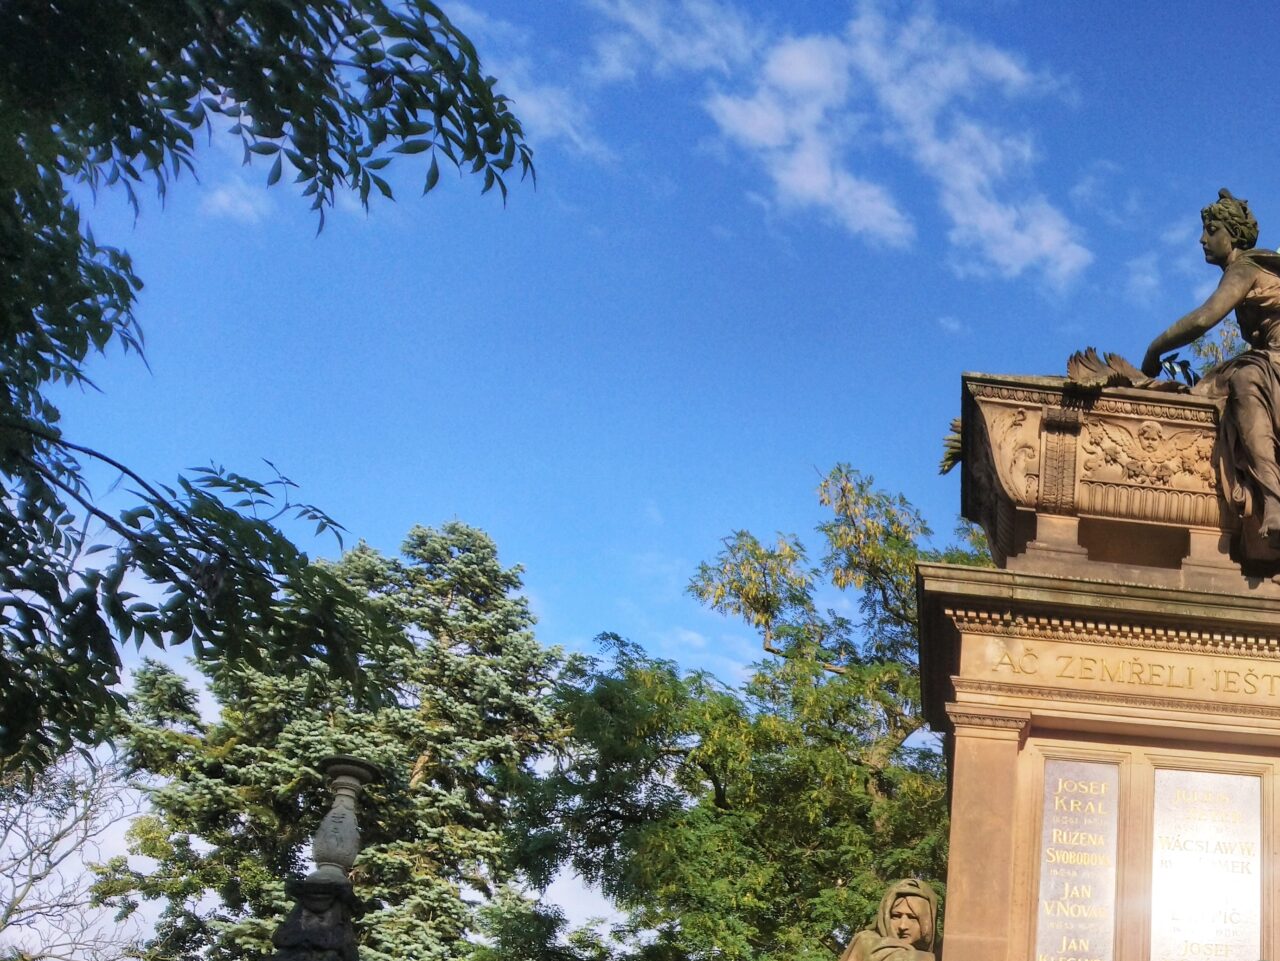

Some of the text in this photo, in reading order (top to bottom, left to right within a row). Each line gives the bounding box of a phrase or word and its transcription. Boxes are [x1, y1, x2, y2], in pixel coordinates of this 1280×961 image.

[991, 647, 1039, 675] AČ
[1055, 655, 1195, 690] ZEMŘELI
[1054, 777, 1109, 795] JOSEF
[1062, 882, 1092, 900] JAN
[1057, 935, 1090, 954] JAN
